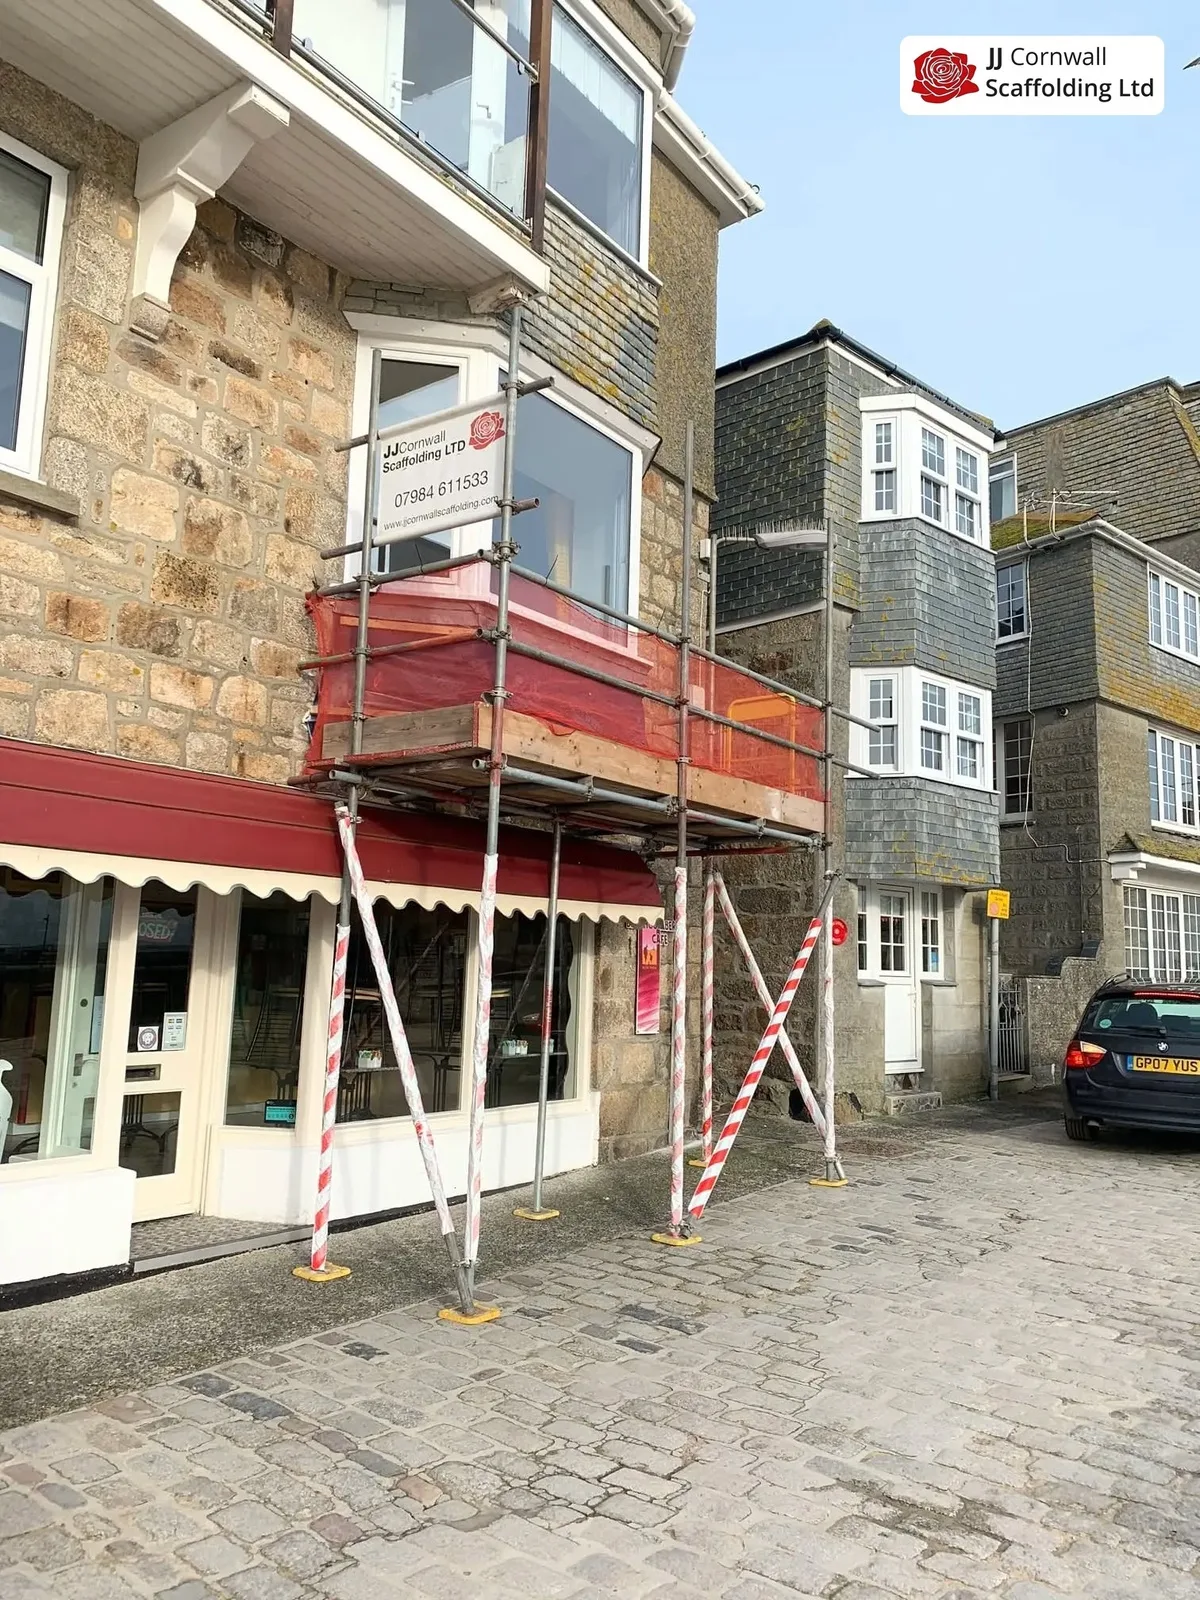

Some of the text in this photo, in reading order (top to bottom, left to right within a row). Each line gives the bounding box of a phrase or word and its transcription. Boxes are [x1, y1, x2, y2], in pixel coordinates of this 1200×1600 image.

[382, 440, 466, 473] Scaffolding LTD
[394, 470, 489, 508] 07984 611533
[383, 495, 499, 530] www.jjcornwallscaffolding.com
[1136, 1057, 1198, 1073] GP07 YUS
